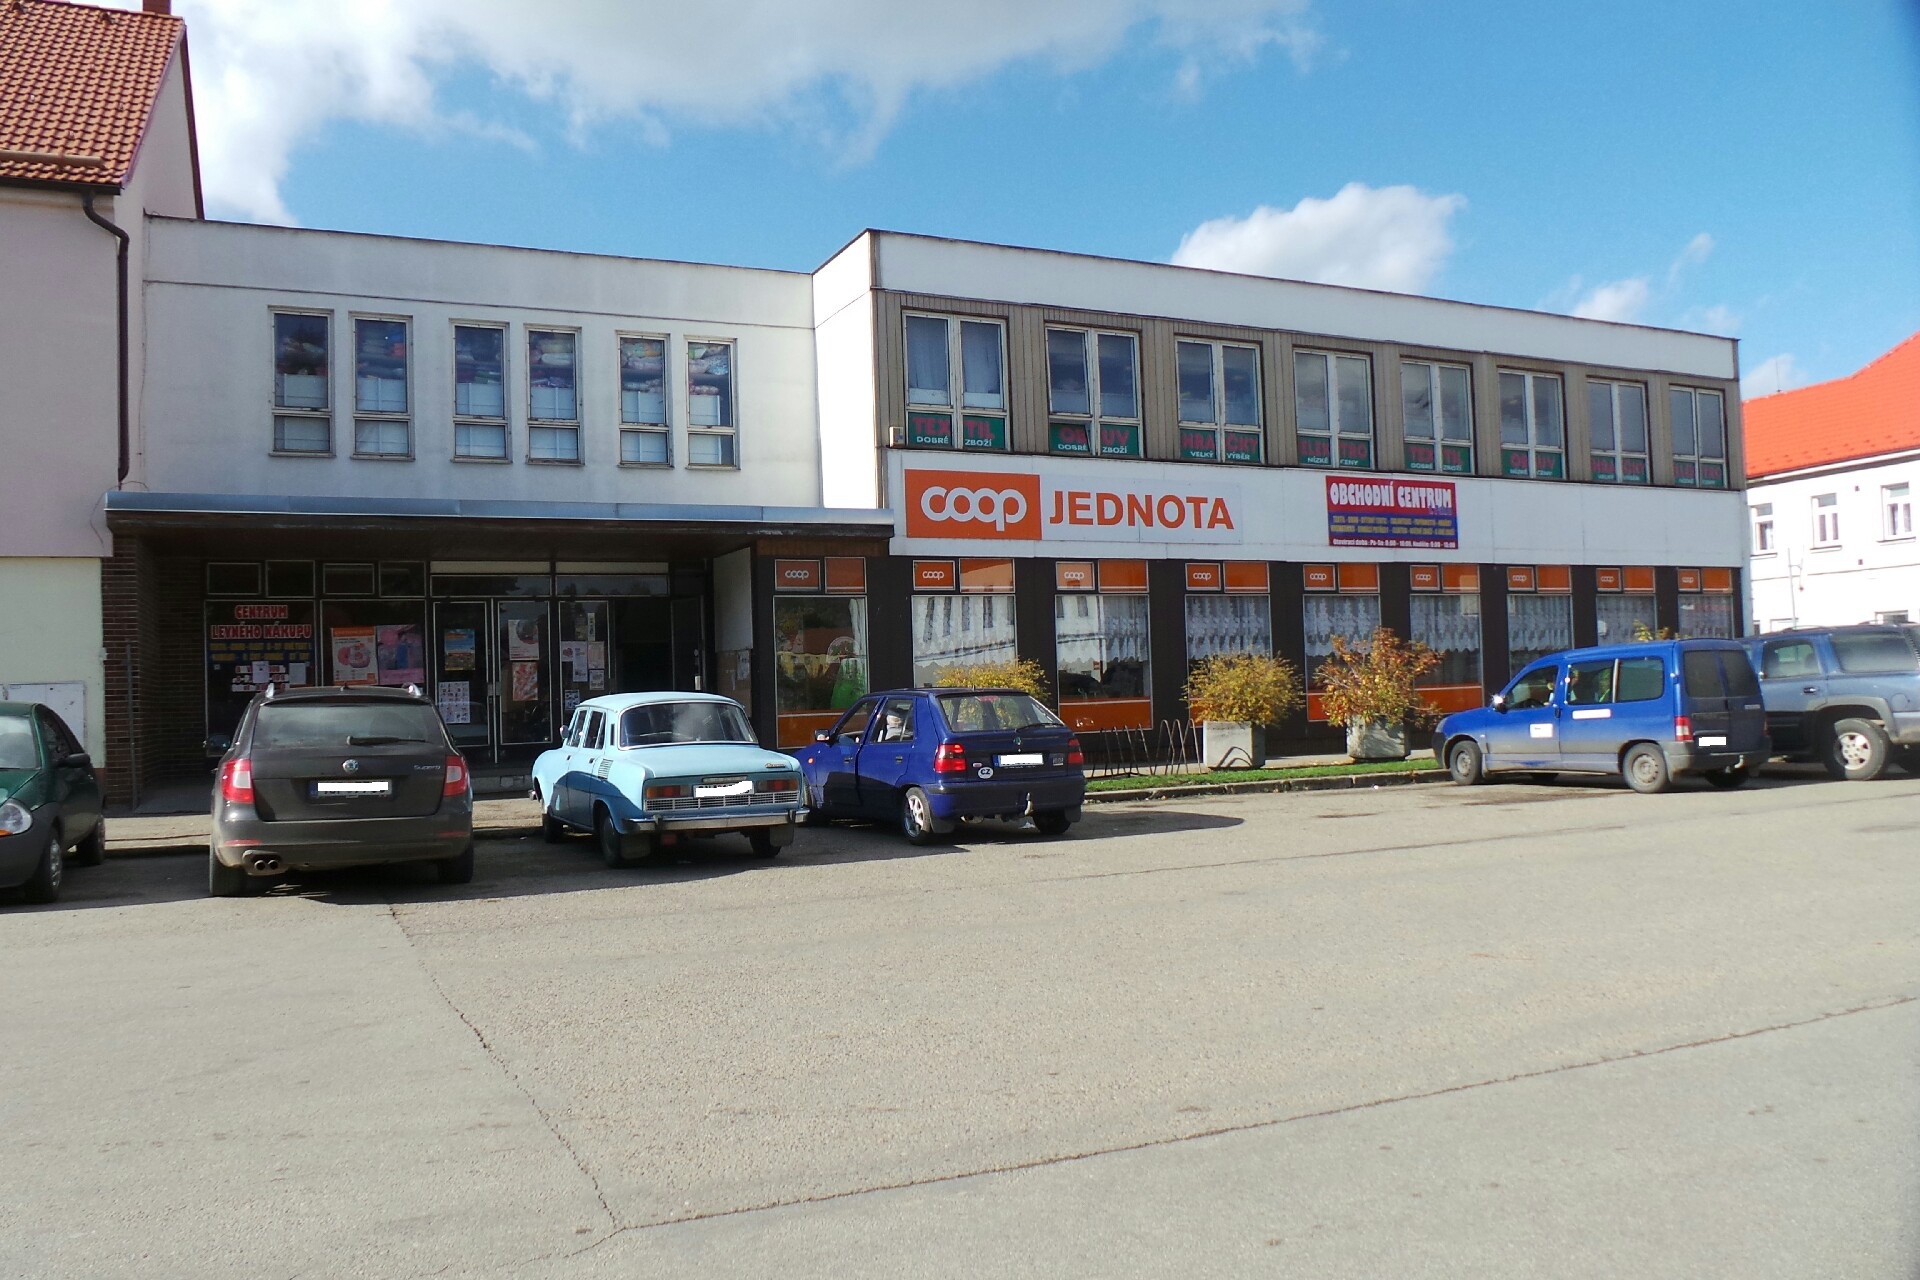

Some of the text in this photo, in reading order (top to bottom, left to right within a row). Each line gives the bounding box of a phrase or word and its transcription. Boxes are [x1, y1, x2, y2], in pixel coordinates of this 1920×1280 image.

[916, 435, 992, 447] DOBRÉ ZBOŽÍ
[1057, 443, 1128, 454] DOBRÉ ZBOŽÍ
[1190, 450, 1251, 460] VELKÝ VÝBĚR
[1307, 455, 1329, 464] NÍZKÉ
[1329, 481, 1452, 508] OBCHODNÍ CENTRUM
[921, 486, 1235, 532] coop JEDNOTA
[785, 570, 809, 580] coop
[922, 570, 945, 580] coop
[1064, 571, 1085, 581] coop
[1192, 572, 1211, 581] coop
[235, 604, 288, 620] CENTRUM
[210, 621, 312, 639] LEVNÉHO NÁKUPU
